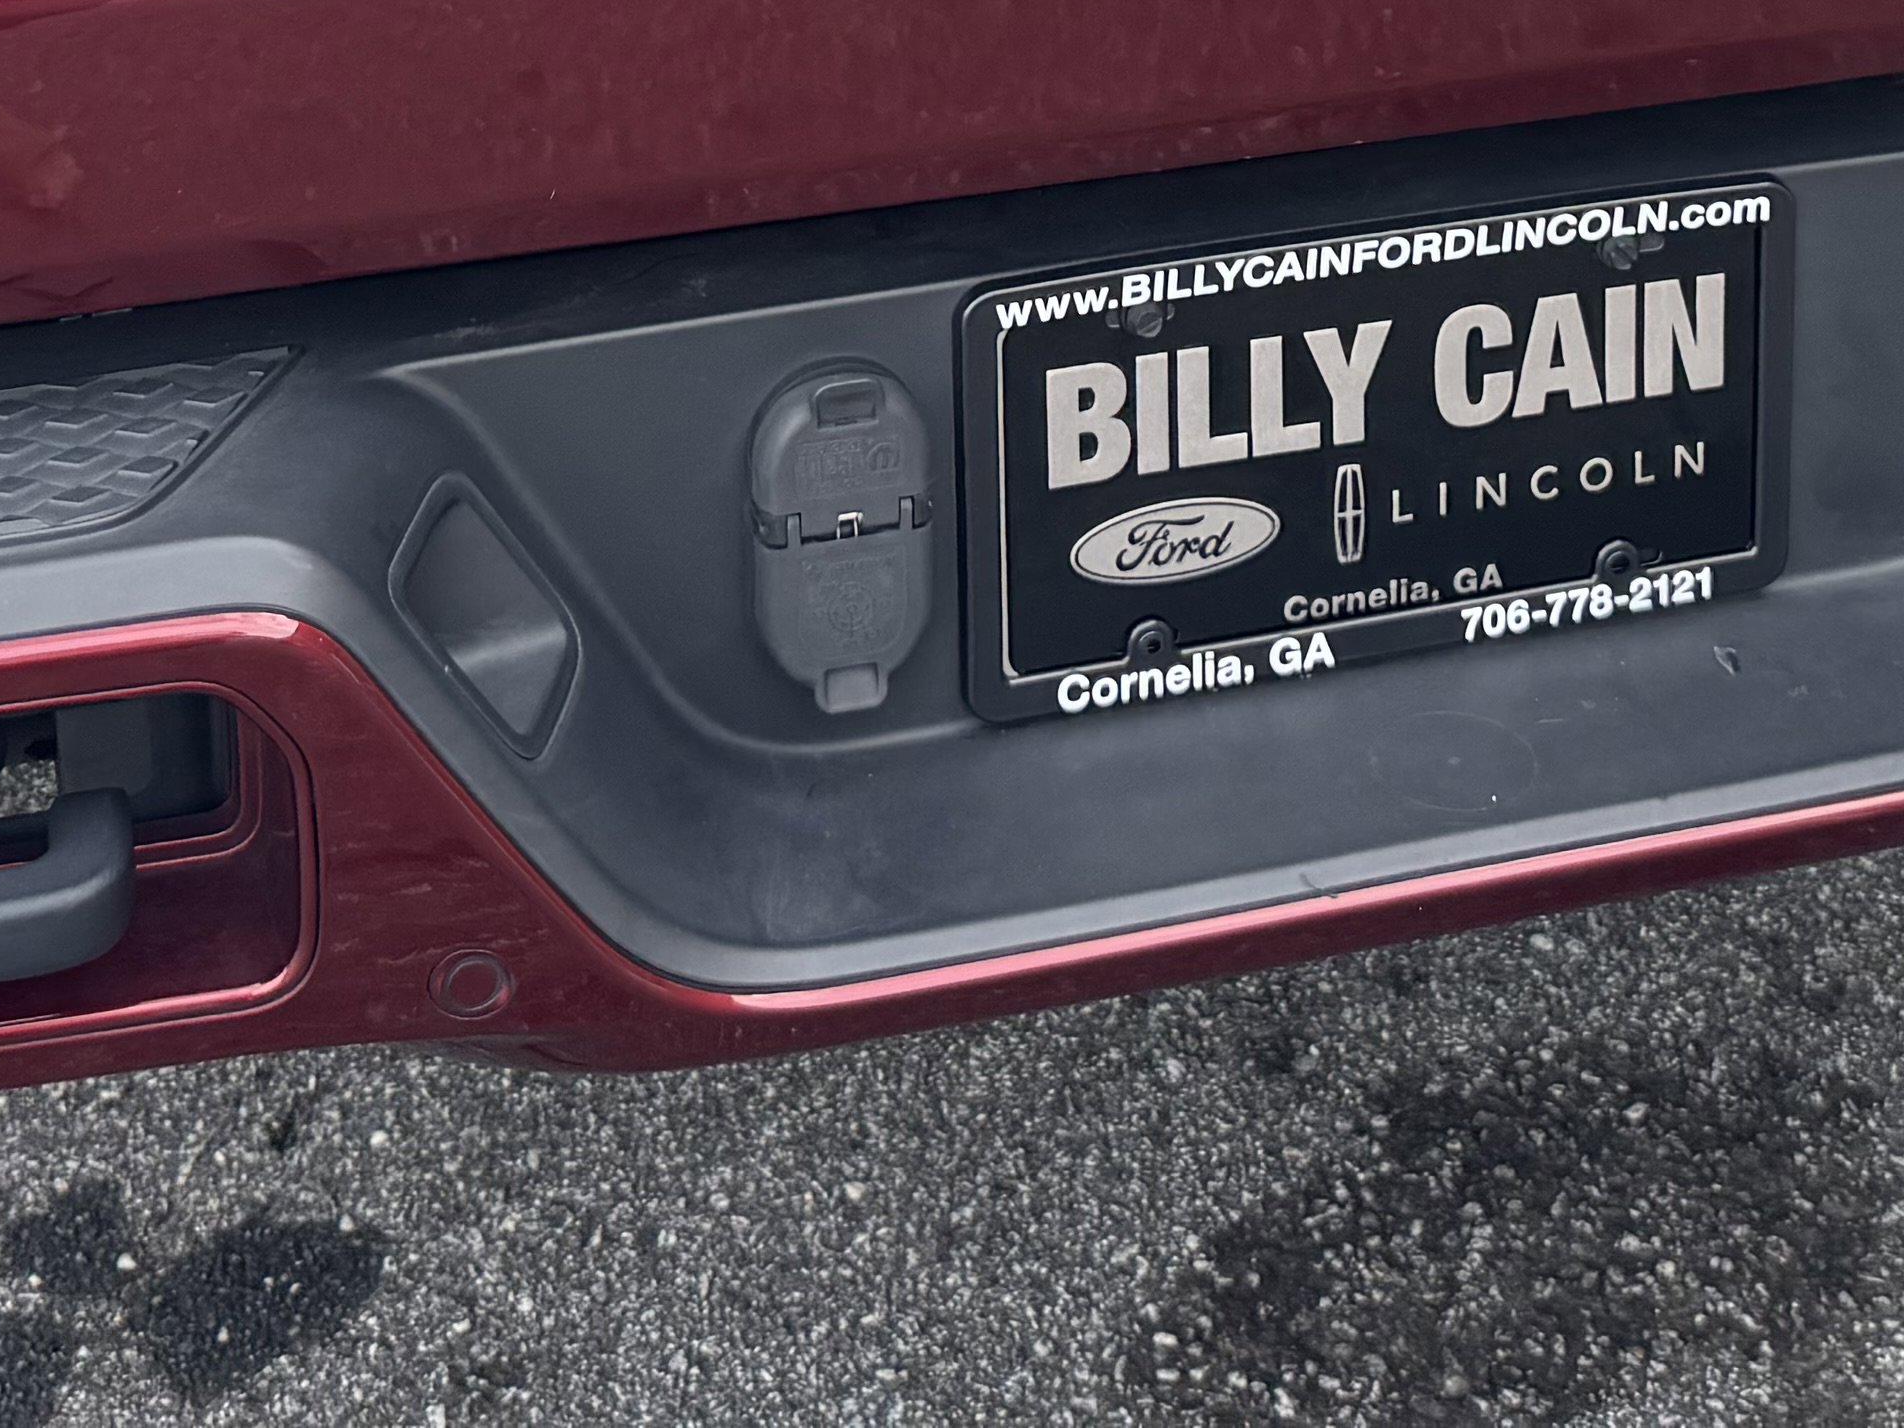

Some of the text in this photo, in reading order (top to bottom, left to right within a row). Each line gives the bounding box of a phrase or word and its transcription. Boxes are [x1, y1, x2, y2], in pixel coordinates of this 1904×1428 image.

[995, 195, 1772, 330] www.BILLYCAINFORDLINCOLN.com
[1045, 272, 1725, 491] BILLY CAIN
[1115, 441, 1705, 572] Ford LINCOLN
[1283, 563, 1504, 623] Cornelia, GA
[1460, 566, 1713, 643] 706-778-2121
[1057, 631, 1336, 714] Cornelia, GA
